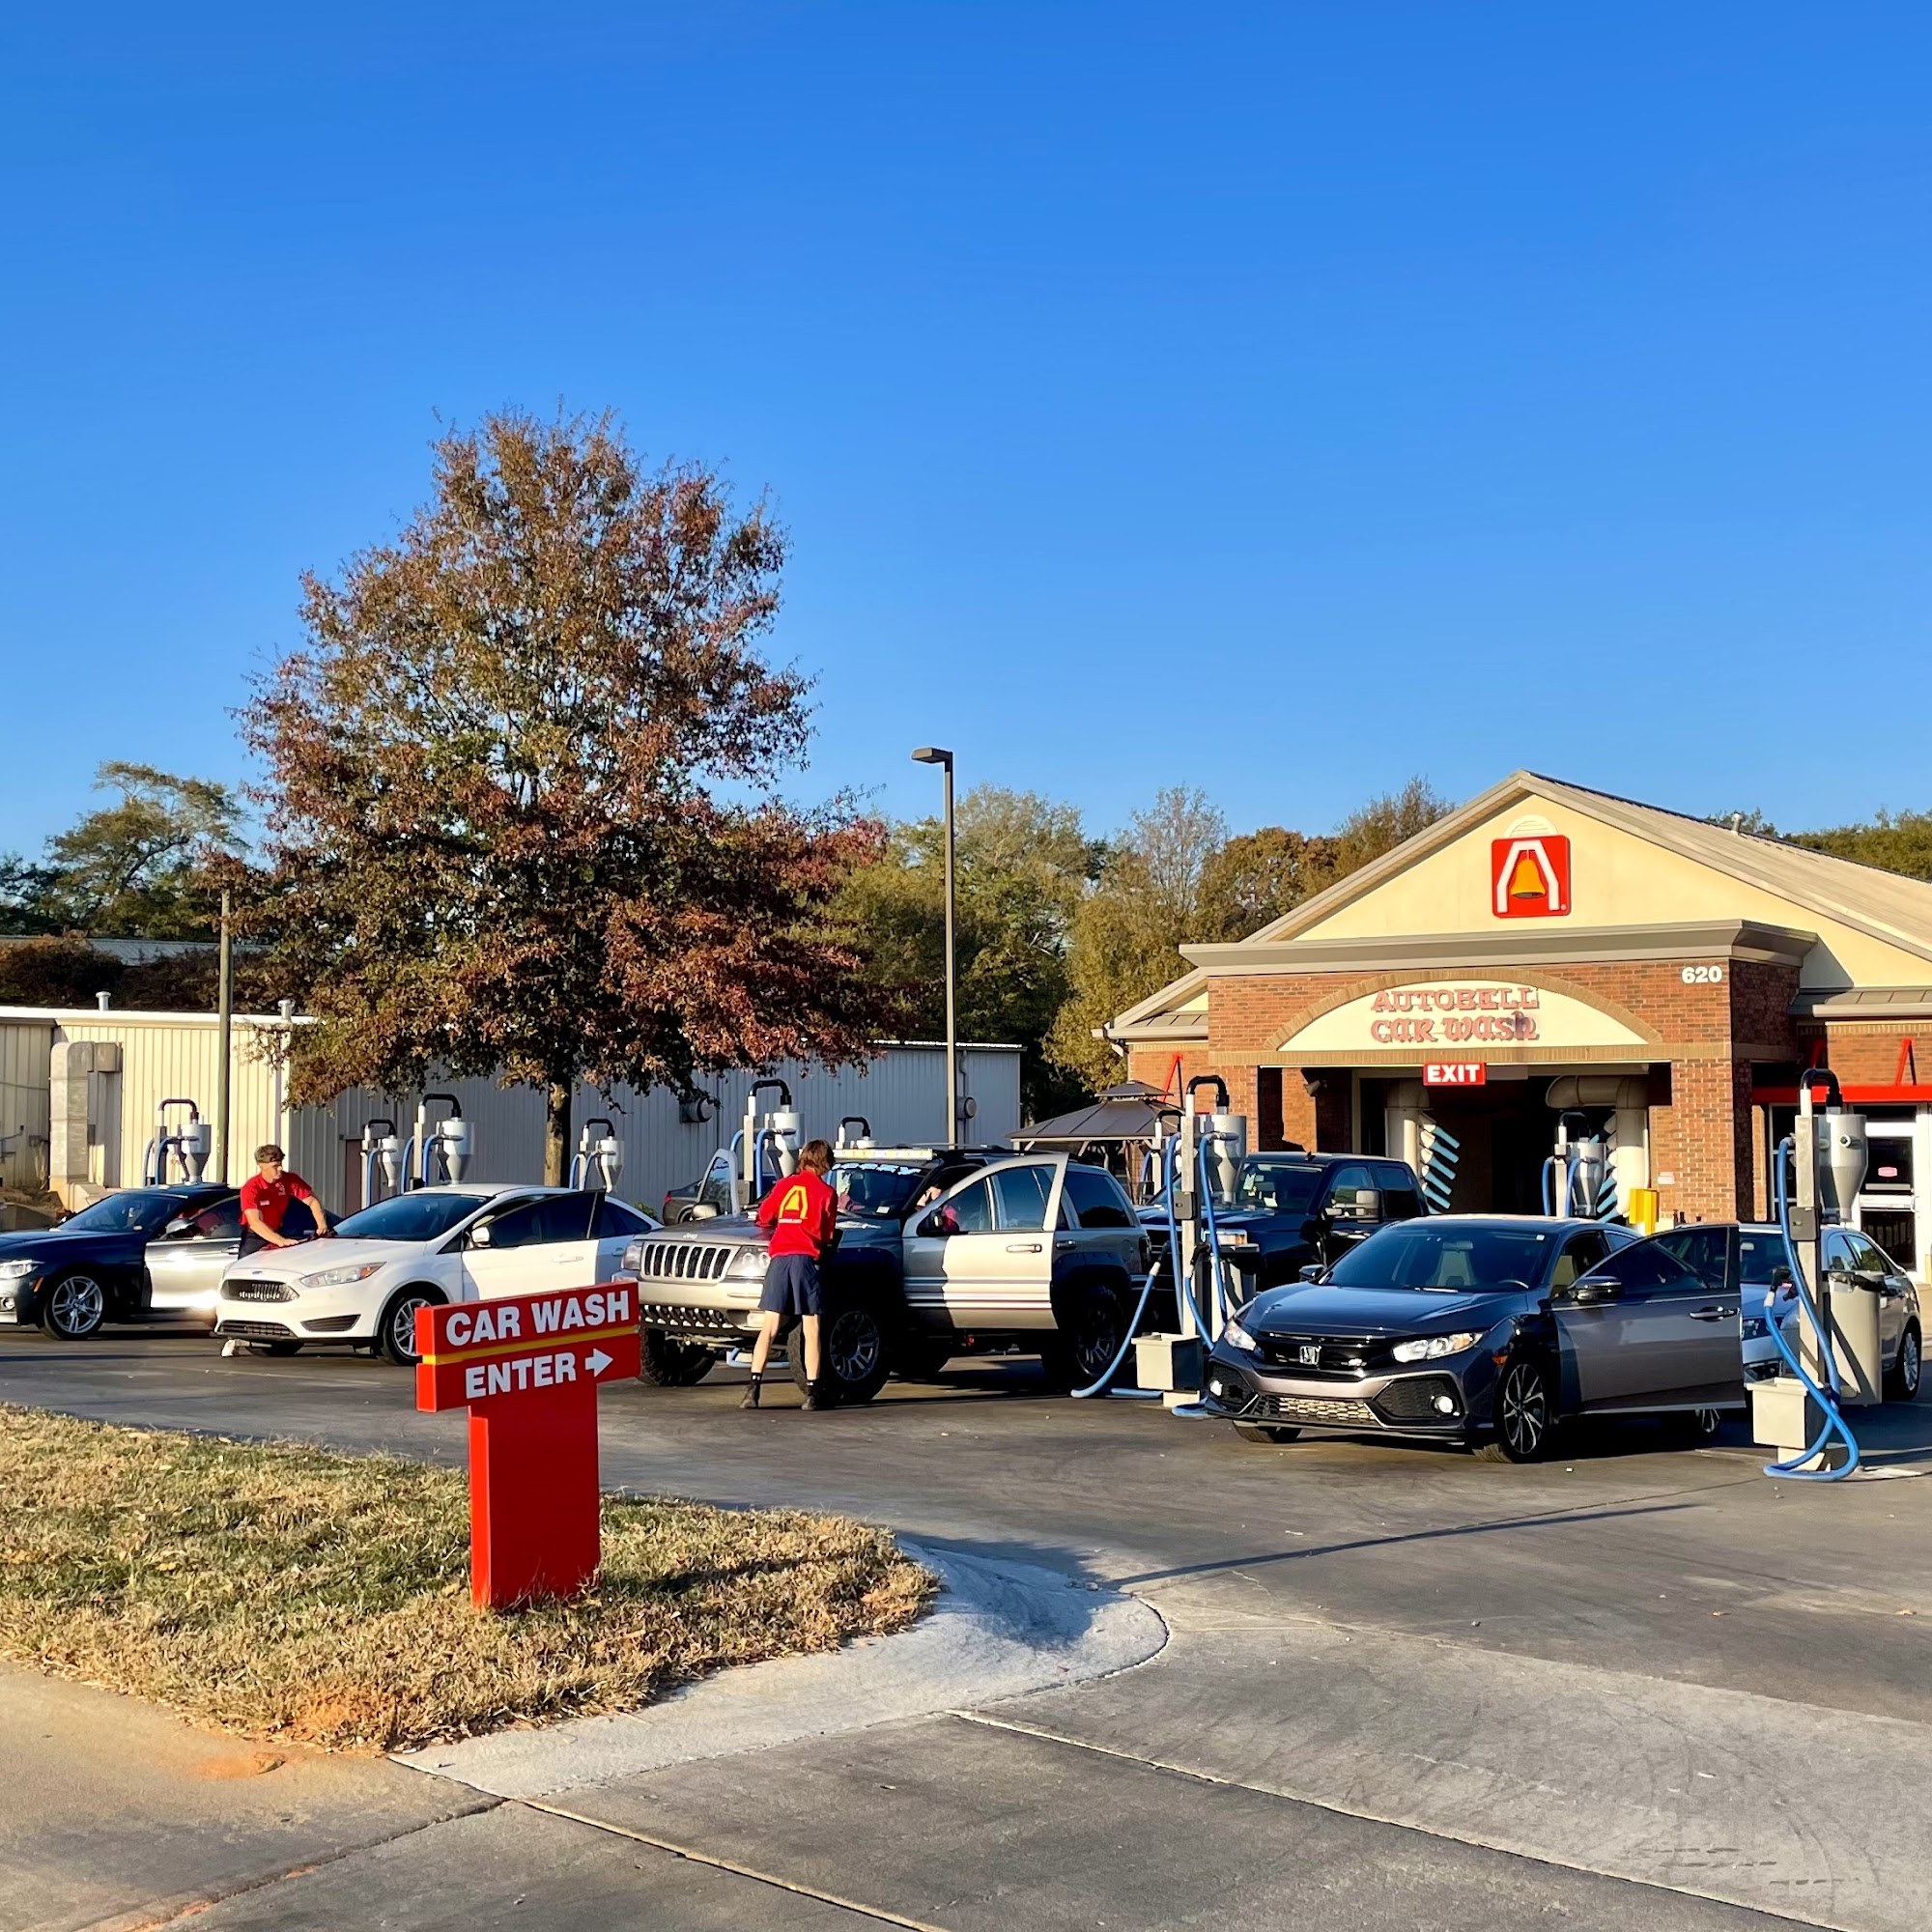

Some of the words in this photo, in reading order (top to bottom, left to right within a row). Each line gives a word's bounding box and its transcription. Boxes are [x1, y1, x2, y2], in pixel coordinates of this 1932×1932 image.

[1681, 965, 1723, 984] 620
[1371, 987, 1540, 1012] AUTOBELL
[1427, 1064, 1481, 1083] EXIT
[445, 1305, 522, 1347] CAR
[530, 1290, 630, 1334] WASH
[465, 1351, 577, 1400] ENTER
